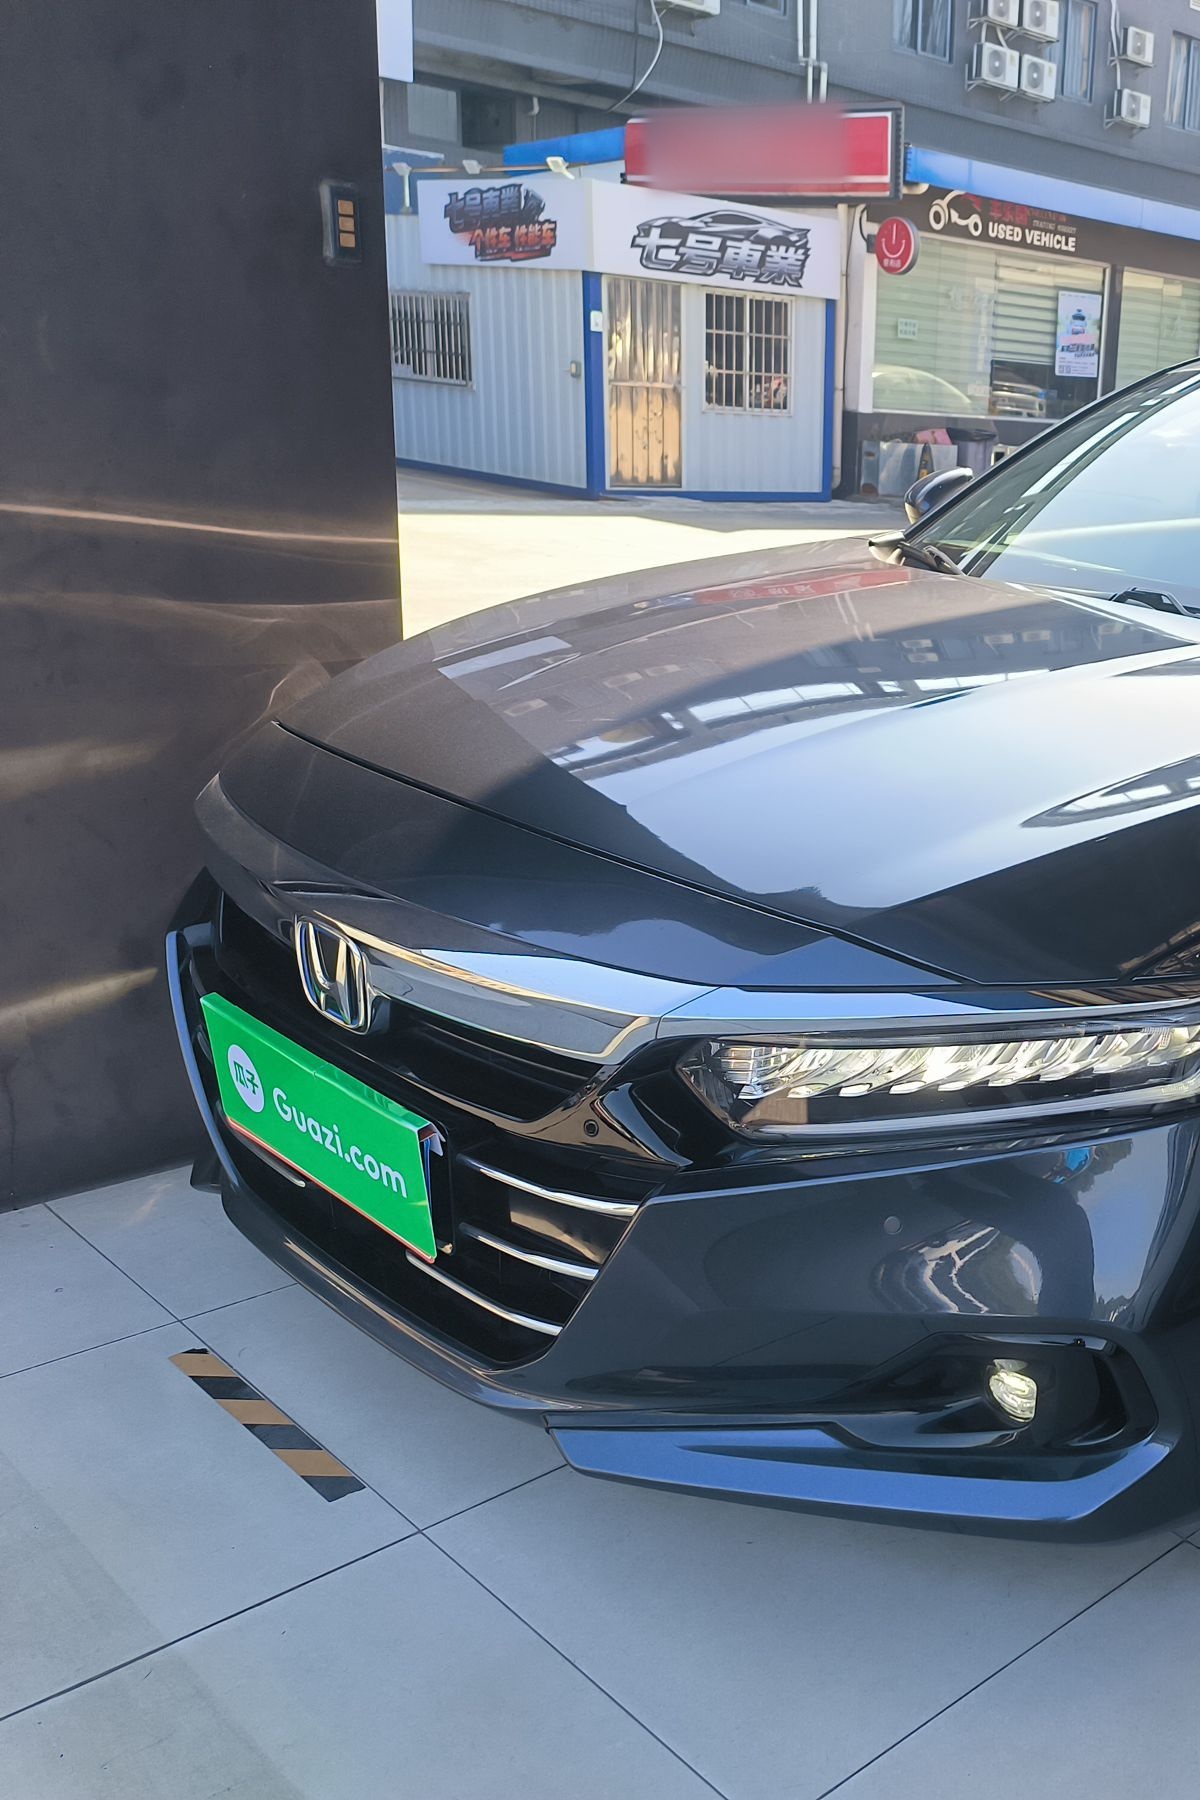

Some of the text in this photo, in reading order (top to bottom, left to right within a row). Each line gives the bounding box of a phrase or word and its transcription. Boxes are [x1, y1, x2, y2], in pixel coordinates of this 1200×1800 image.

[631, 227, 811, 288] 七号車業
[988, 221, 1077, 252] USED VEHICLE
[233, 1060, 259, 1095] 瓜子
[272, 1087, 407, 1199] Guazi.com
